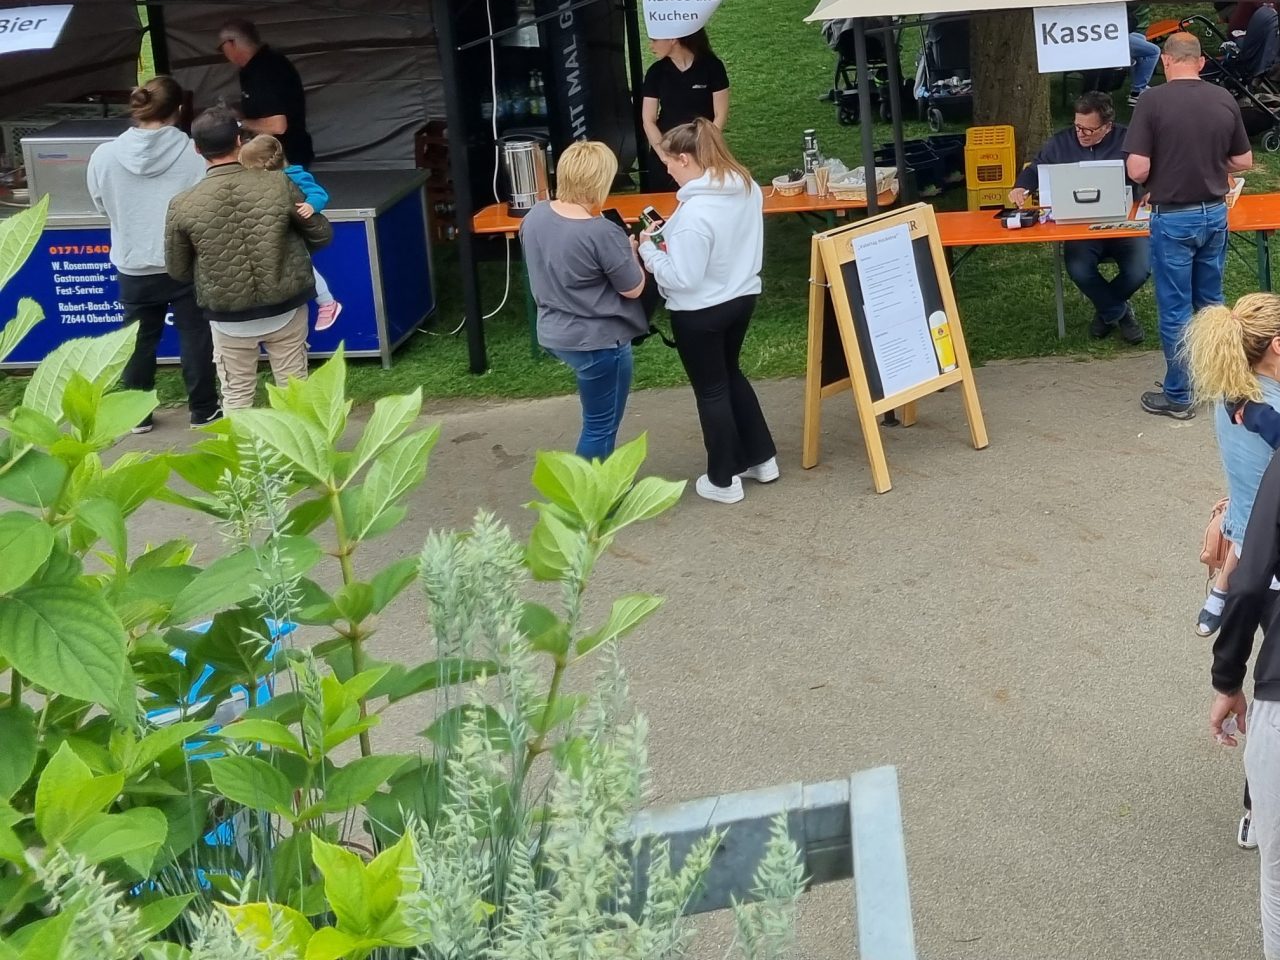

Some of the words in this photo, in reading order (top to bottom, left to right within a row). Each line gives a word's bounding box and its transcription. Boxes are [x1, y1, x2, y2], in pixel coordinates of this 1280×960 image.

[650, 10, 699, 22] Kuchen
[0, 16, 48, 34] Bier
[1040, 21, 1120, 46] Kasse
[563, 33, 583, 98] MAL
[48, 244, 110, 255] 0171/540
[51, 261, 62, 271] W.
[63, 260, 112, 272] Rosenmayer
[55, 285, 104, 295] Fest-Service
[58, 301, 125, 312] Robert-Bosch-St
[60, 314, 86, 324] 72644
[86, 313, 125, 323] Oberboih
